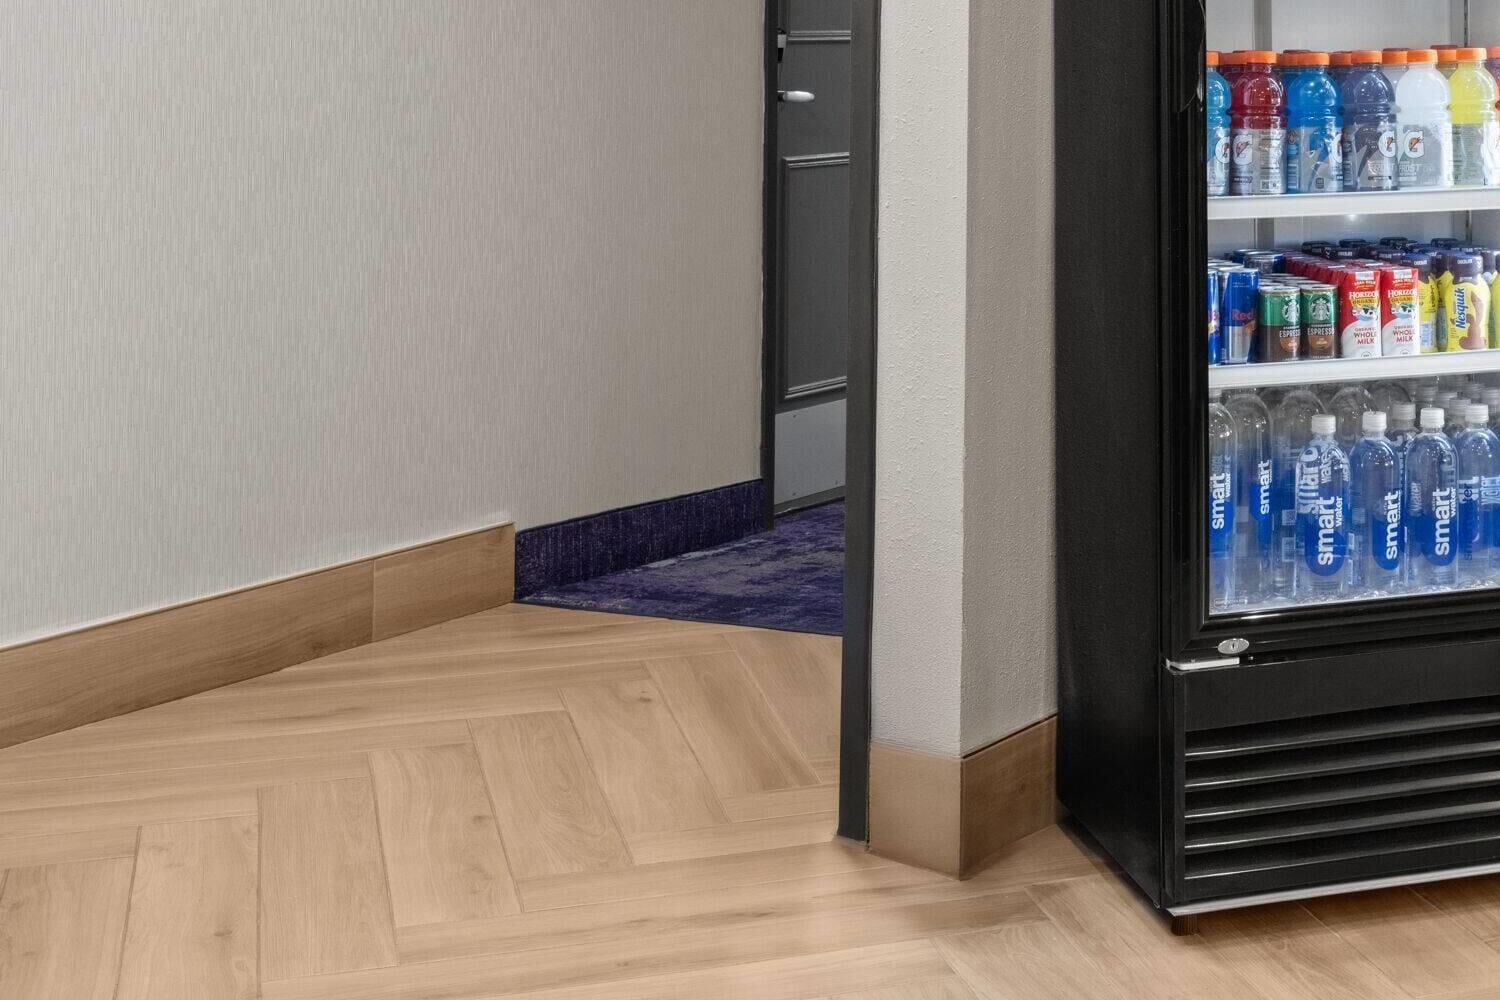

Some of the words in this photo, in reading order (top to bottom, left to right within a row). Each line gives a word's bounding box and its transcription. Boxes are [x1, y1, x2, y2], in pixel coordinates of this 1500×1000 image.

[1349, 290, 1379, 300] HORIZO
[1387, 288, 1417, 299] HORIZO
[1455, 287, 1468, 329] Nesquik
[1210, 473, 1226, 530] smart
[1257, 459, 1270, 515] smart
[1334, 496, 1343, 528] water
[1316, 496, 1335, 566] smart
[1384, 490, 1400, 560] smart
[1432, 487, 1450, 556] smart
